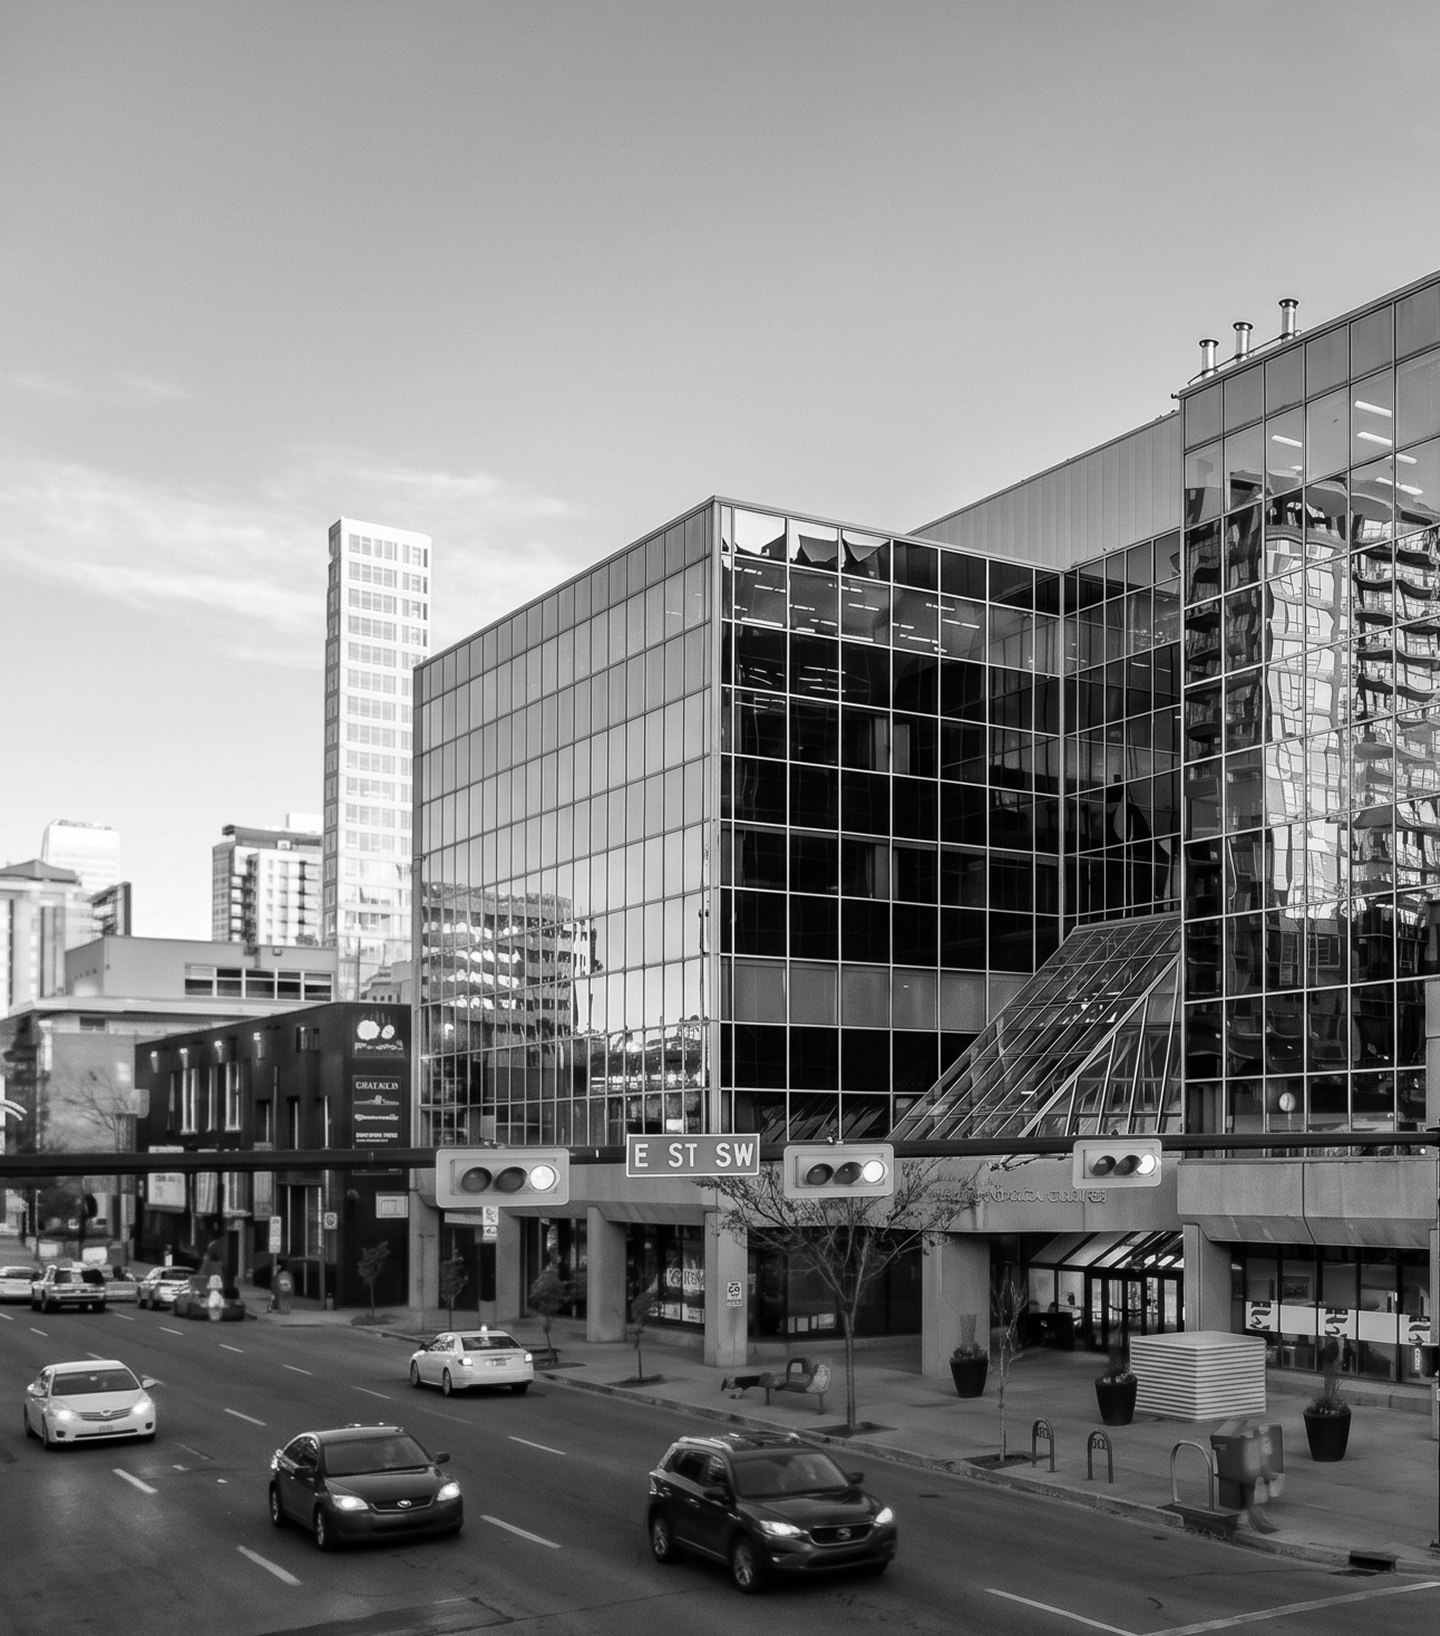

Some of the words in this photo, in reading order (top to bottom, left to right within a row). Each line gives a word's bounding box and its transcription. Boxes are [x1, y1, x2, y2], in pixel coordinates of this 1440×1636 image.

[634, 1143, 649, 1168] E
[668, 1142, 698, 1168] ST
[715, 1142, 754, 1168] SW
